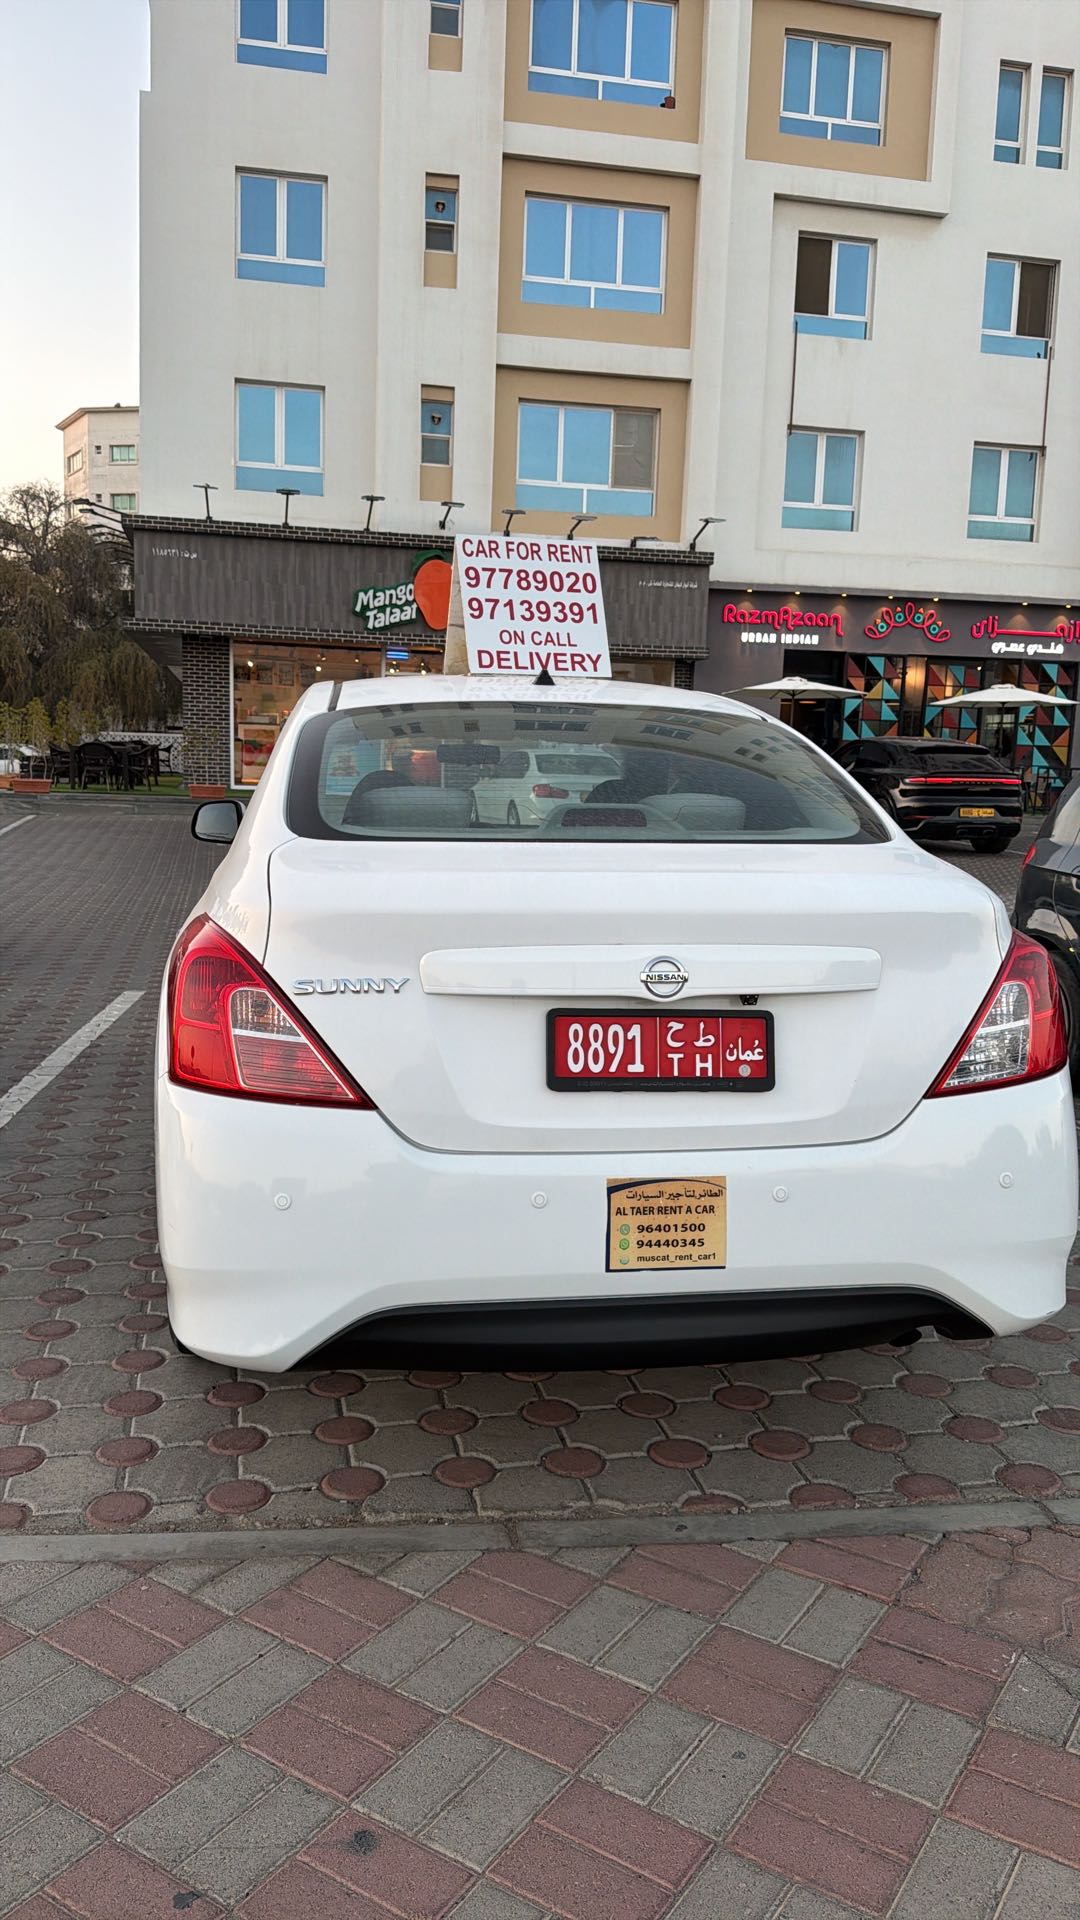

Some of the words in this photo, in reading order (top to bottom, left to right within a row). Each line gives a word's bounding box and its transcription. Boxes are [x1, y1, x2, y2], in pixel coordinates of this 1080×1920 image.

[462, 538, 501, 559] CAR
[505, 541, 543, 561] FOR
[547, 543, 593, 564] RENT
[464, 566, 597, 594] 97789020
[355, 583, 415, 613] Mango
[365, 602, 418, 630] Talaat
[467, 597, 598, 625] 97139391
[499, 629, 526, 646] ON
[531, 630, 578, 647] CALL
[741, 632, 777, 644] URBAN
[780, 633, 819, 645] INDIAN
[477, 649, 602, 673] DELIVERY
[646, 973, 684, 981] NISSAN
[293, 977, 411, 996] SUNNY
[567, 1022, 645, 1074] 8891
[626, 1189, 664, 1202] السيارات
[615, 1206, 628, 1216] AL
[630, 1206, 655, 1216] TAER
[657, 1205, 683, 1215] RENT
[685, 1205, 692, 1214] A
[695, 1204, 715, 1214] CAR
[637, 1223, 706, 1233] 96401500
[636, 1238, 705, 1249] 94440345
[637, 1252, 716, 1263] muscat_rent_car1
